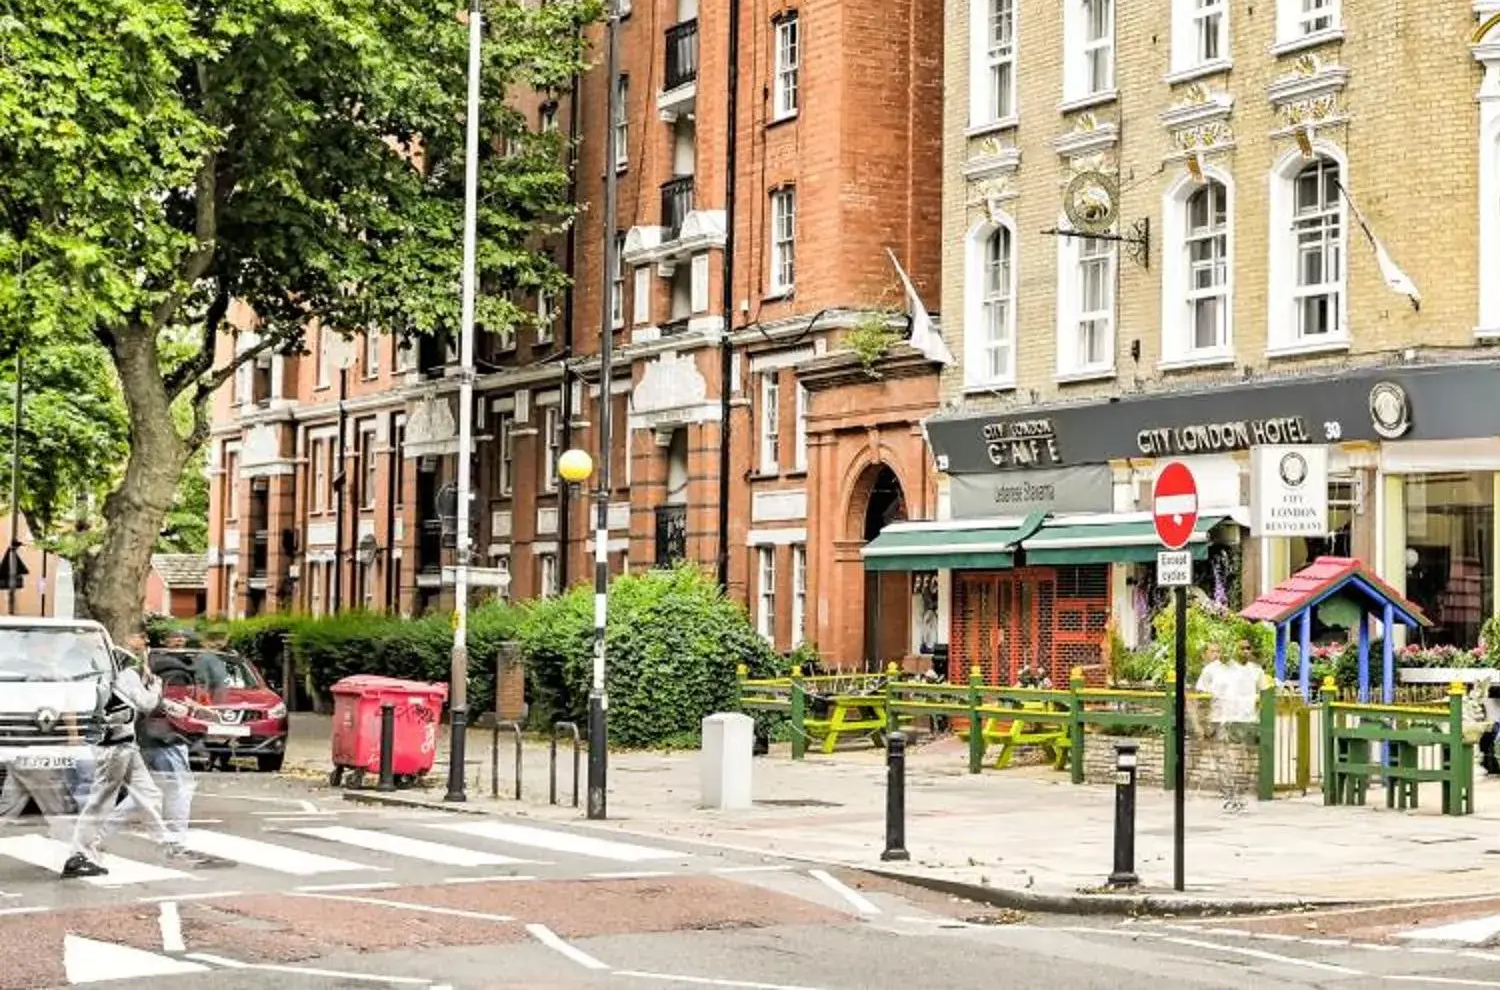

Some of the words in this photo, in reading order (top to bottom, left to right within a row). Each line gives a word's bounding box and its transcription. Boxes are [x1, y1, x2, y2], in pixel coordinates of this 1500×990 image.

[1010, 419, 1052, 437] LONDON
[1137, 428, 1171, 453] CITY
[1176, 422, 1250, 451] LONDON
[1253, 416, 1309, 443] HOTEL
[1282, 495, 1303, 503] CITY
[1271, 507, 1316, 518] LONDON
[1161, 554, 1187, 566] Except
[1161, 570, 1187, 583] cycles
